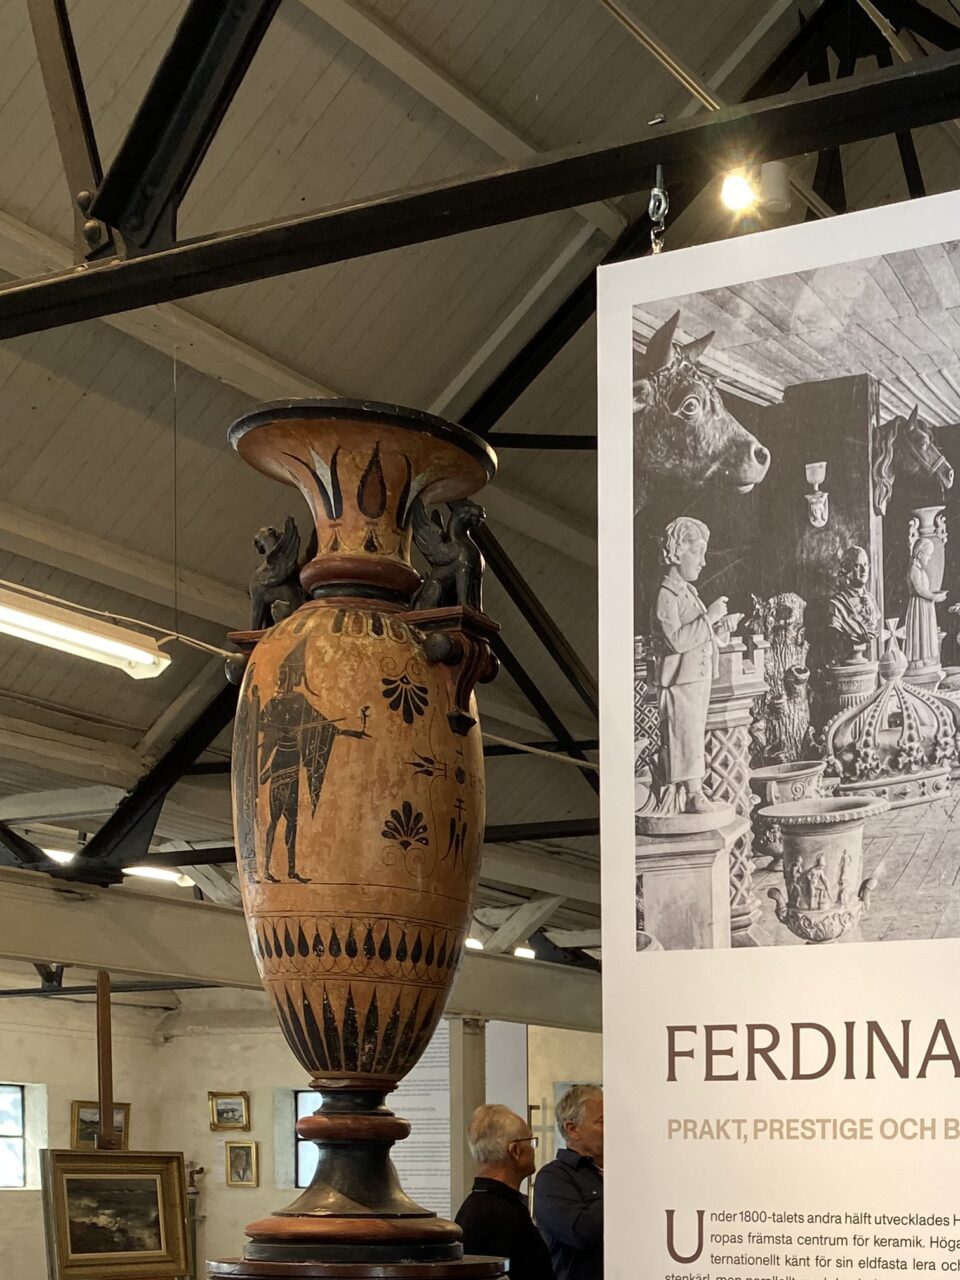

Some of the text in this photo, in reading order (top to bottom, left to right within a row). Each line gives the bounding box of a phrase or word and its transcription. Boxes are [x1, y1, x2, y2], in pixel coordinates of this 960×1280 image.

[667, 1118, 749, 1145] PRAKT,
[752, 1117, 874, 1141] PRESTIGE
[878, 1117, 937, 1141] OCH
[709, 1233, 744, 1247] ropas
[746, 1230, 793, 1246] främsta
[796, 1233, 849, 1247] centrum
[852, 1233, 870, 1247] för
[873, 1233, 926, 1249] keramik.
